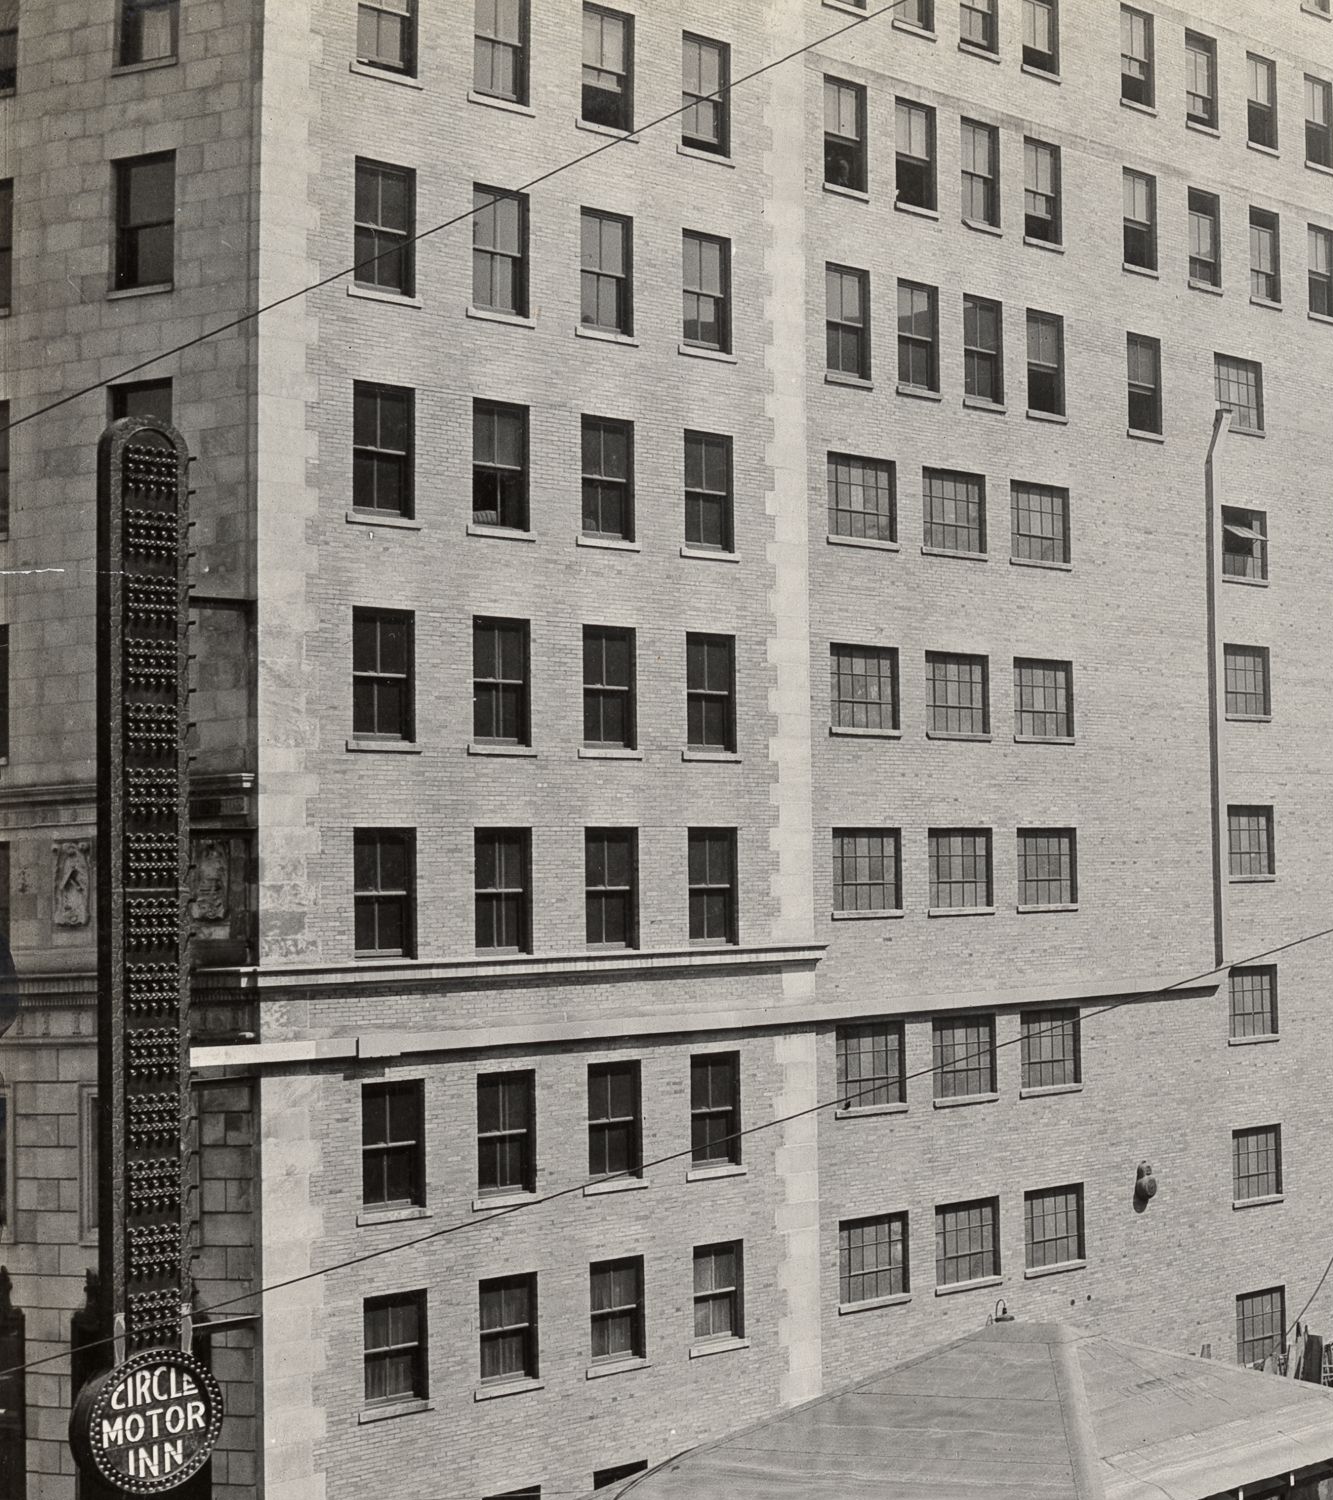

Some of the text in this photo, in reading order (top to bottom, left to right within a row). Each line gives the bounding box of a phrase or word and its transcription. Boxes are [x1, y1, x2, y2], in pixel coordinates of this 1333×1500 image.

[111, 1366, 199, 1411] CIRCLE
[102, 1401, 206, 1449] MOTOR
[128, 1439, 184, 1478] INN
